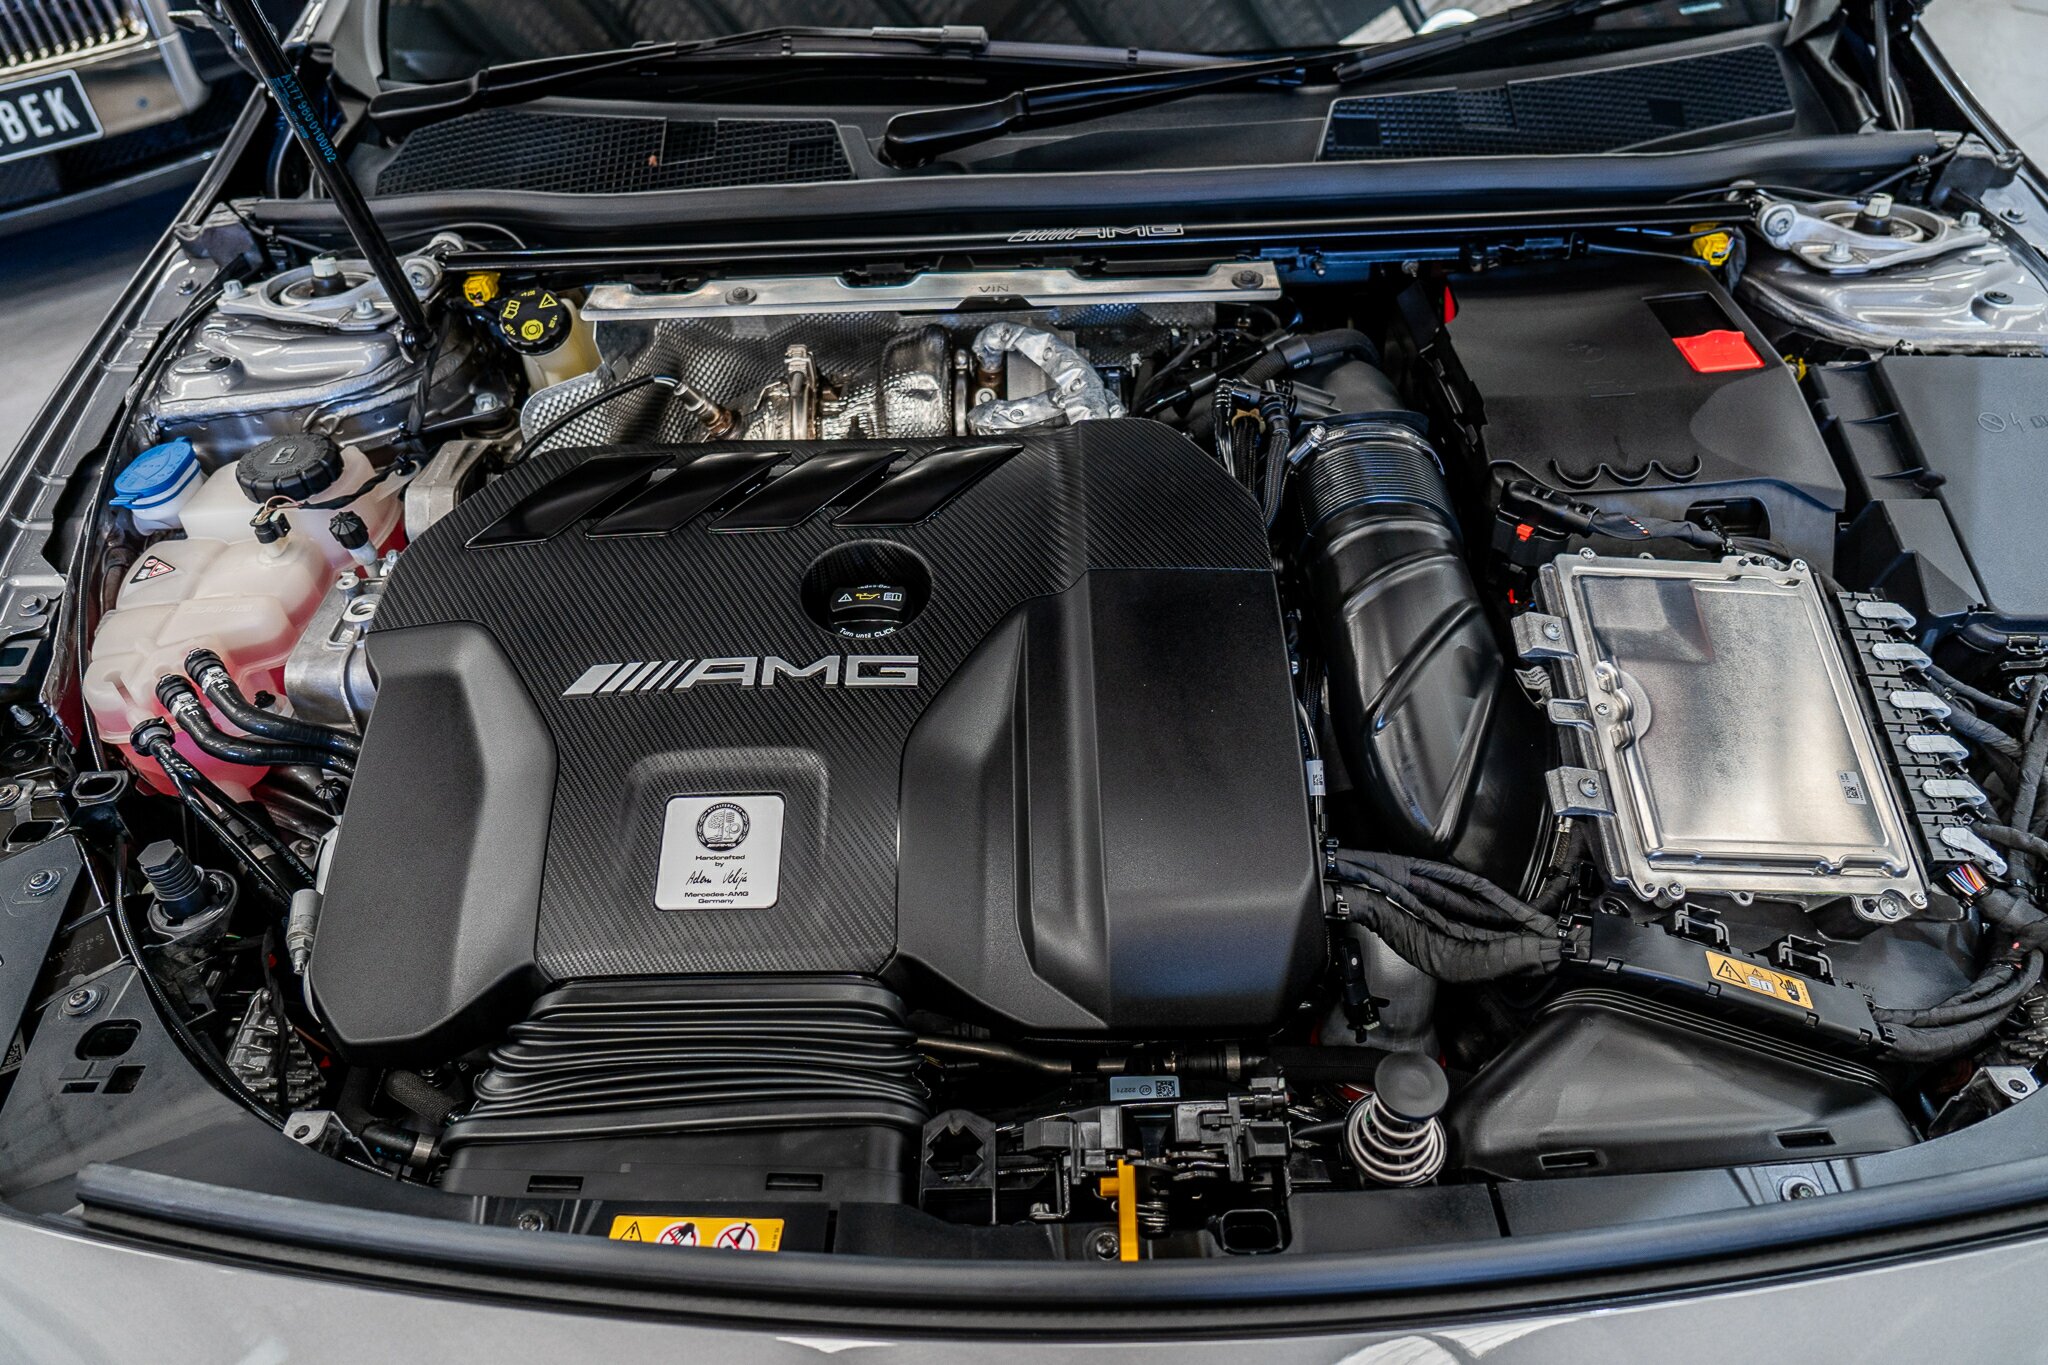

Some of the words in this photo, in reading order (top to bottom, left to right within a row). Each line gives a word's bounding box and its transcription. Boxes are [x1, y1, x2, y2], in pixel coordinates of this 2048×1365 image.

[0, 86, 80, 146] BEK
[298, 100, 315, 122] 980
[1066, 224, 1184, 240] AMG
[978, 284, 1009, 293] VIN
[839, 627, 854, 637] Turn
[873, 626, 897, 638] CLICK
[672, 655, 919, 692] AMG
[684, 890, 749, 898] Mercedes-AMG
